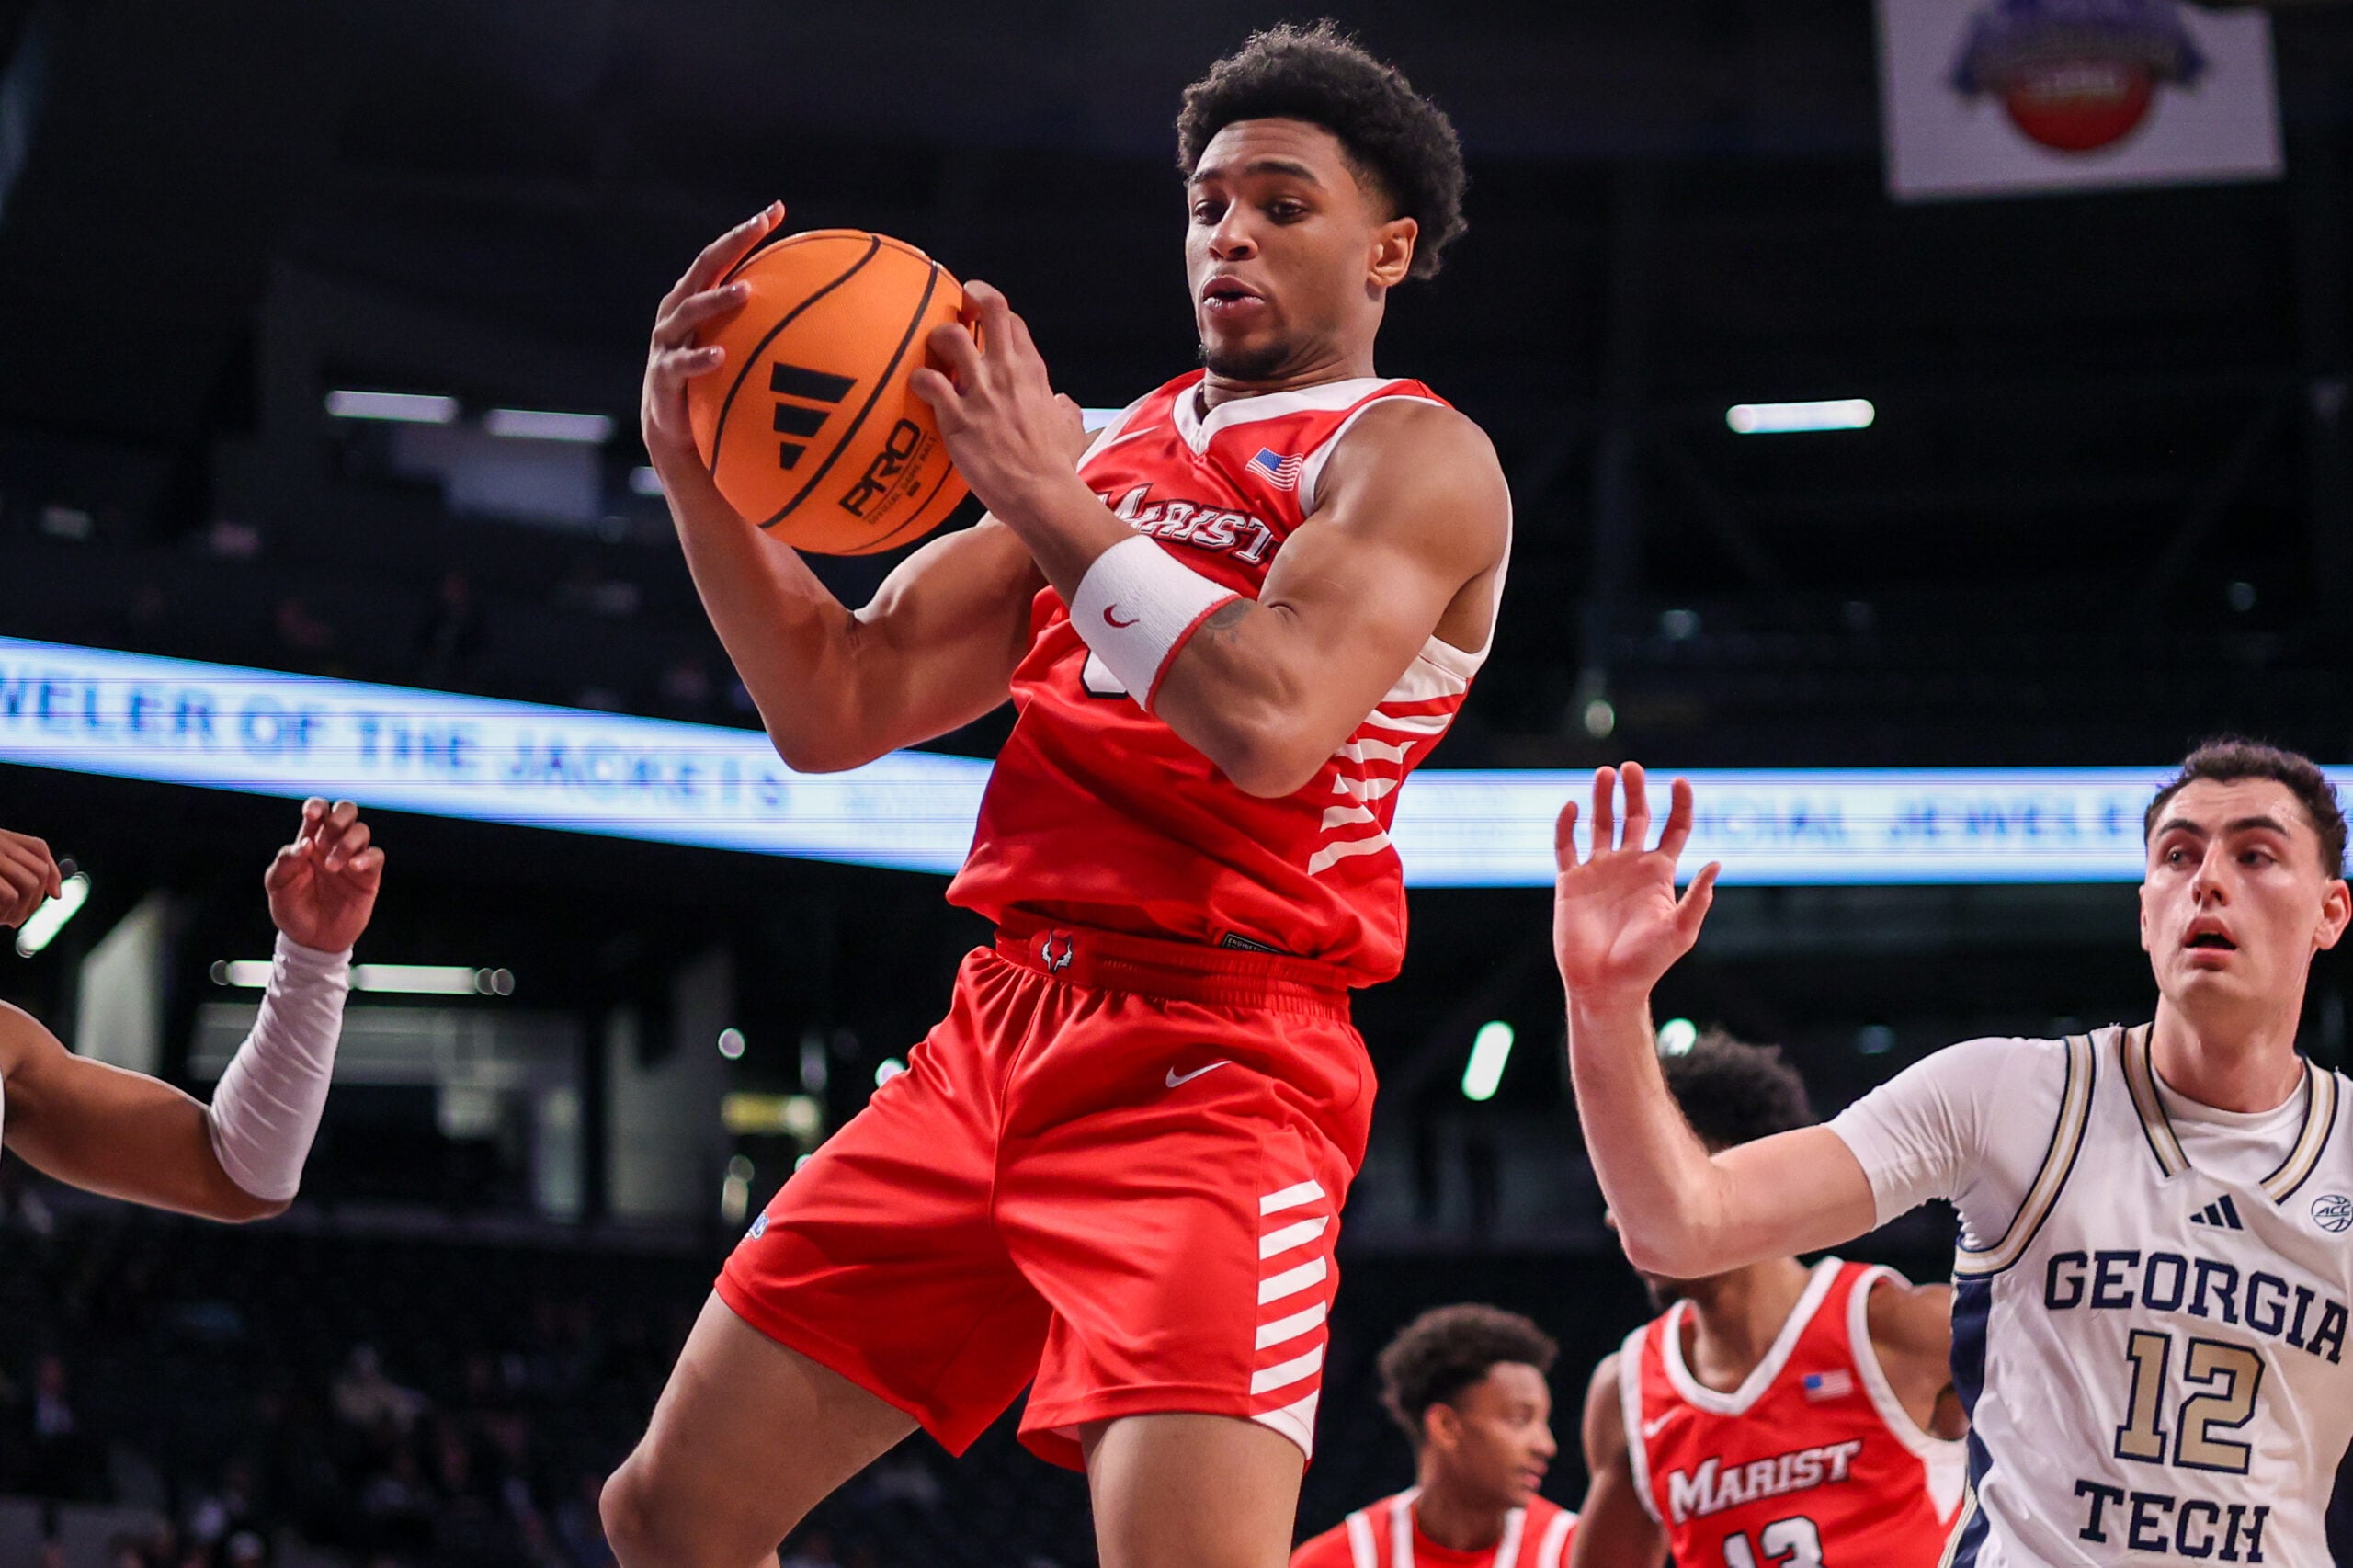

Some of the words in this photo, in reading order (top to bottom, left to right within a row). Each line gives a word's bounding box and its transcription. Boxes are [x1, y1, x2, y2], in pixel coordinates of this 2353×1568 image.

[838, 418, 921, 517] PRO
[237, 689, 331, 770] OF
[349, 708, 487, 789] THE
[498, 726, 793, 823] JACKETS
[1886, 789, 2143, 846] JEWELE
[2313, 1205, 2351, 1217] ACC
[2043, 1249, 2349, 1365] GEORGIA
[2115, 1329, 2267, 1475] 12
[1667, 1438, 1864, 1527] MARIST
[2074, 1478, 2270, 1563] TECH
